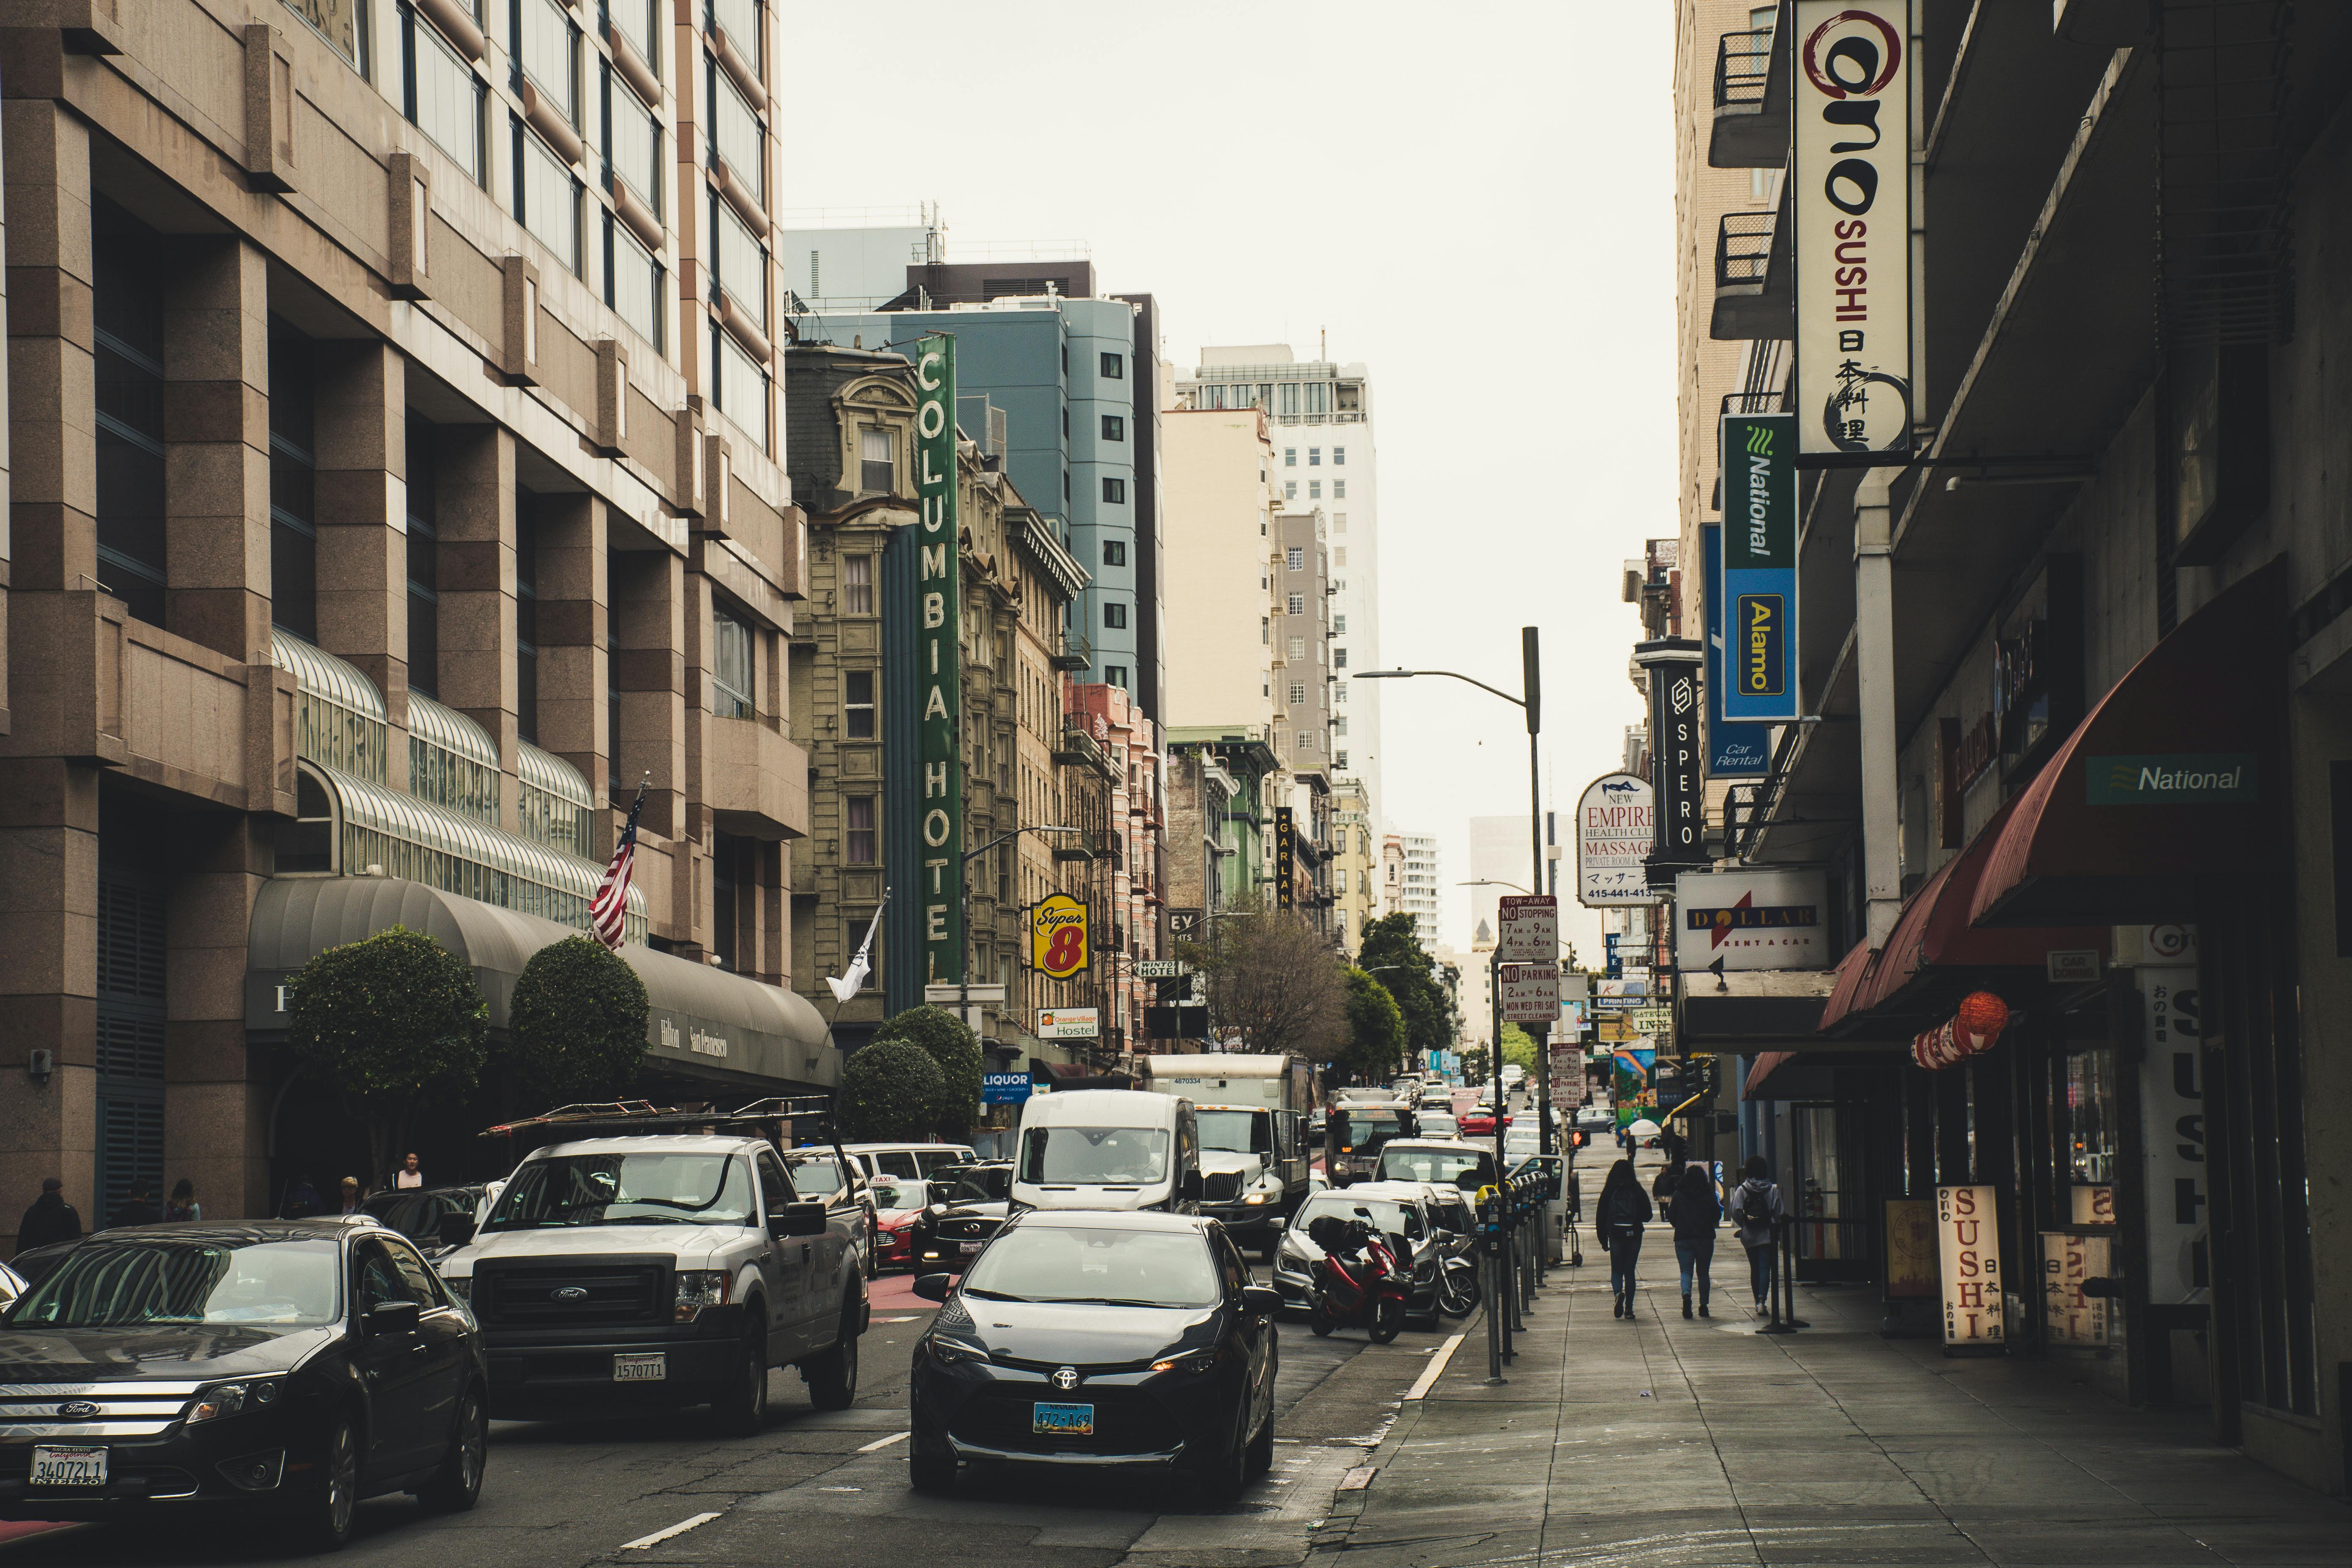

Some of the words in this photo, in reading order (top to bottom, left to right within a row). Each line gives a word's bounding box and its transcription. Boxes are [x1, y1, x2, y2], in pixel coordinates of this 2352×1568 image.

[1822, 36, 1880, 215] ono
[1835, 220, 1867, 322] SUSHI
[1835, 331, 1869, 444] 日本料理
[1750, 456, 1770, 556] National
[918, 352, 948, 721] COLUMBIA
[1751, 601, 1771, 690] Alamo
[1726, 744, 1751, 754] Car
[1716, 755, 1763, 766] Rental
[1677, 724, 1692, 844] SPERO
[2138, 766, 2241, 790] National
[1609, 794, 1633, 804] NEW
[1586, 828, 1626, 837] HEALTH
[1631, 828, 1652, 836] CLU
[1586, 857, 1610, 866] PRIVATE
[1612, 857, 1630, 866] ROOM
[1632, 857, 1636, 866] &
[924, 761, 950, 984] HOTEL
[1588, 889, 1652, 897] 415-441-413
[1506, 897, 1550, 905] TOW-AWAY
[1036, 906, 1083, 934] Super
[1502, 907, 1516, 920] NO
[1519, 909, 1554, 918] STOPPING
[1695, 909, 1811, 927] DOLLAR
[1506, 923, 1512, 934] 7
[1533, 923, 1540, 933] 9
[1506, 936, 1513, 947] 4
[1533, 936, 1540, 947] 6
[1043, 926, 1083, 972] 8
[2062, 957, 2085, 966] CAR
[1503, 967, 1517, 982] NO
[1522, 969, 1556, 980] PARKING
[2053, 968, 2093, 977] COMING
[1508, 987, 1514, 997] 2
[1536, 986, 1542, 997] 6
[1506, 1002, 1519, 1011] MON
[1521, 1002, 1532, 1011] WED
[1535, 1002, 1543, 1010] FRI
[1546, 1001, 1555, 1010] SAT
[1057, 1025, 1094, 1035] Hostel
[1639, 1020, 1667, 1029] INN
[661, 1018, 679, 1048] Hilton
[690, 1026, 701, 1052] San
[701, 1029, 727, 1057] Francisco
[984, 1075, 1028, 1086] LIQUOR
[1954, 1189, 1984, 1339] SUSHI
[558, 1290, 579, 1298] Ford
[1984, 1259, 2003, 1339] 日本料理
[617, 1364, 663, 1377] 15707T1
[66, 1403, 91, 1413] Ford
[1037, 1412, 1059, 1427] 472
[1068, 1413, 1089, 1427] A69
[49, 1451, 95, 1460] California
[37, 1461, 101, 1479] 34072L1
